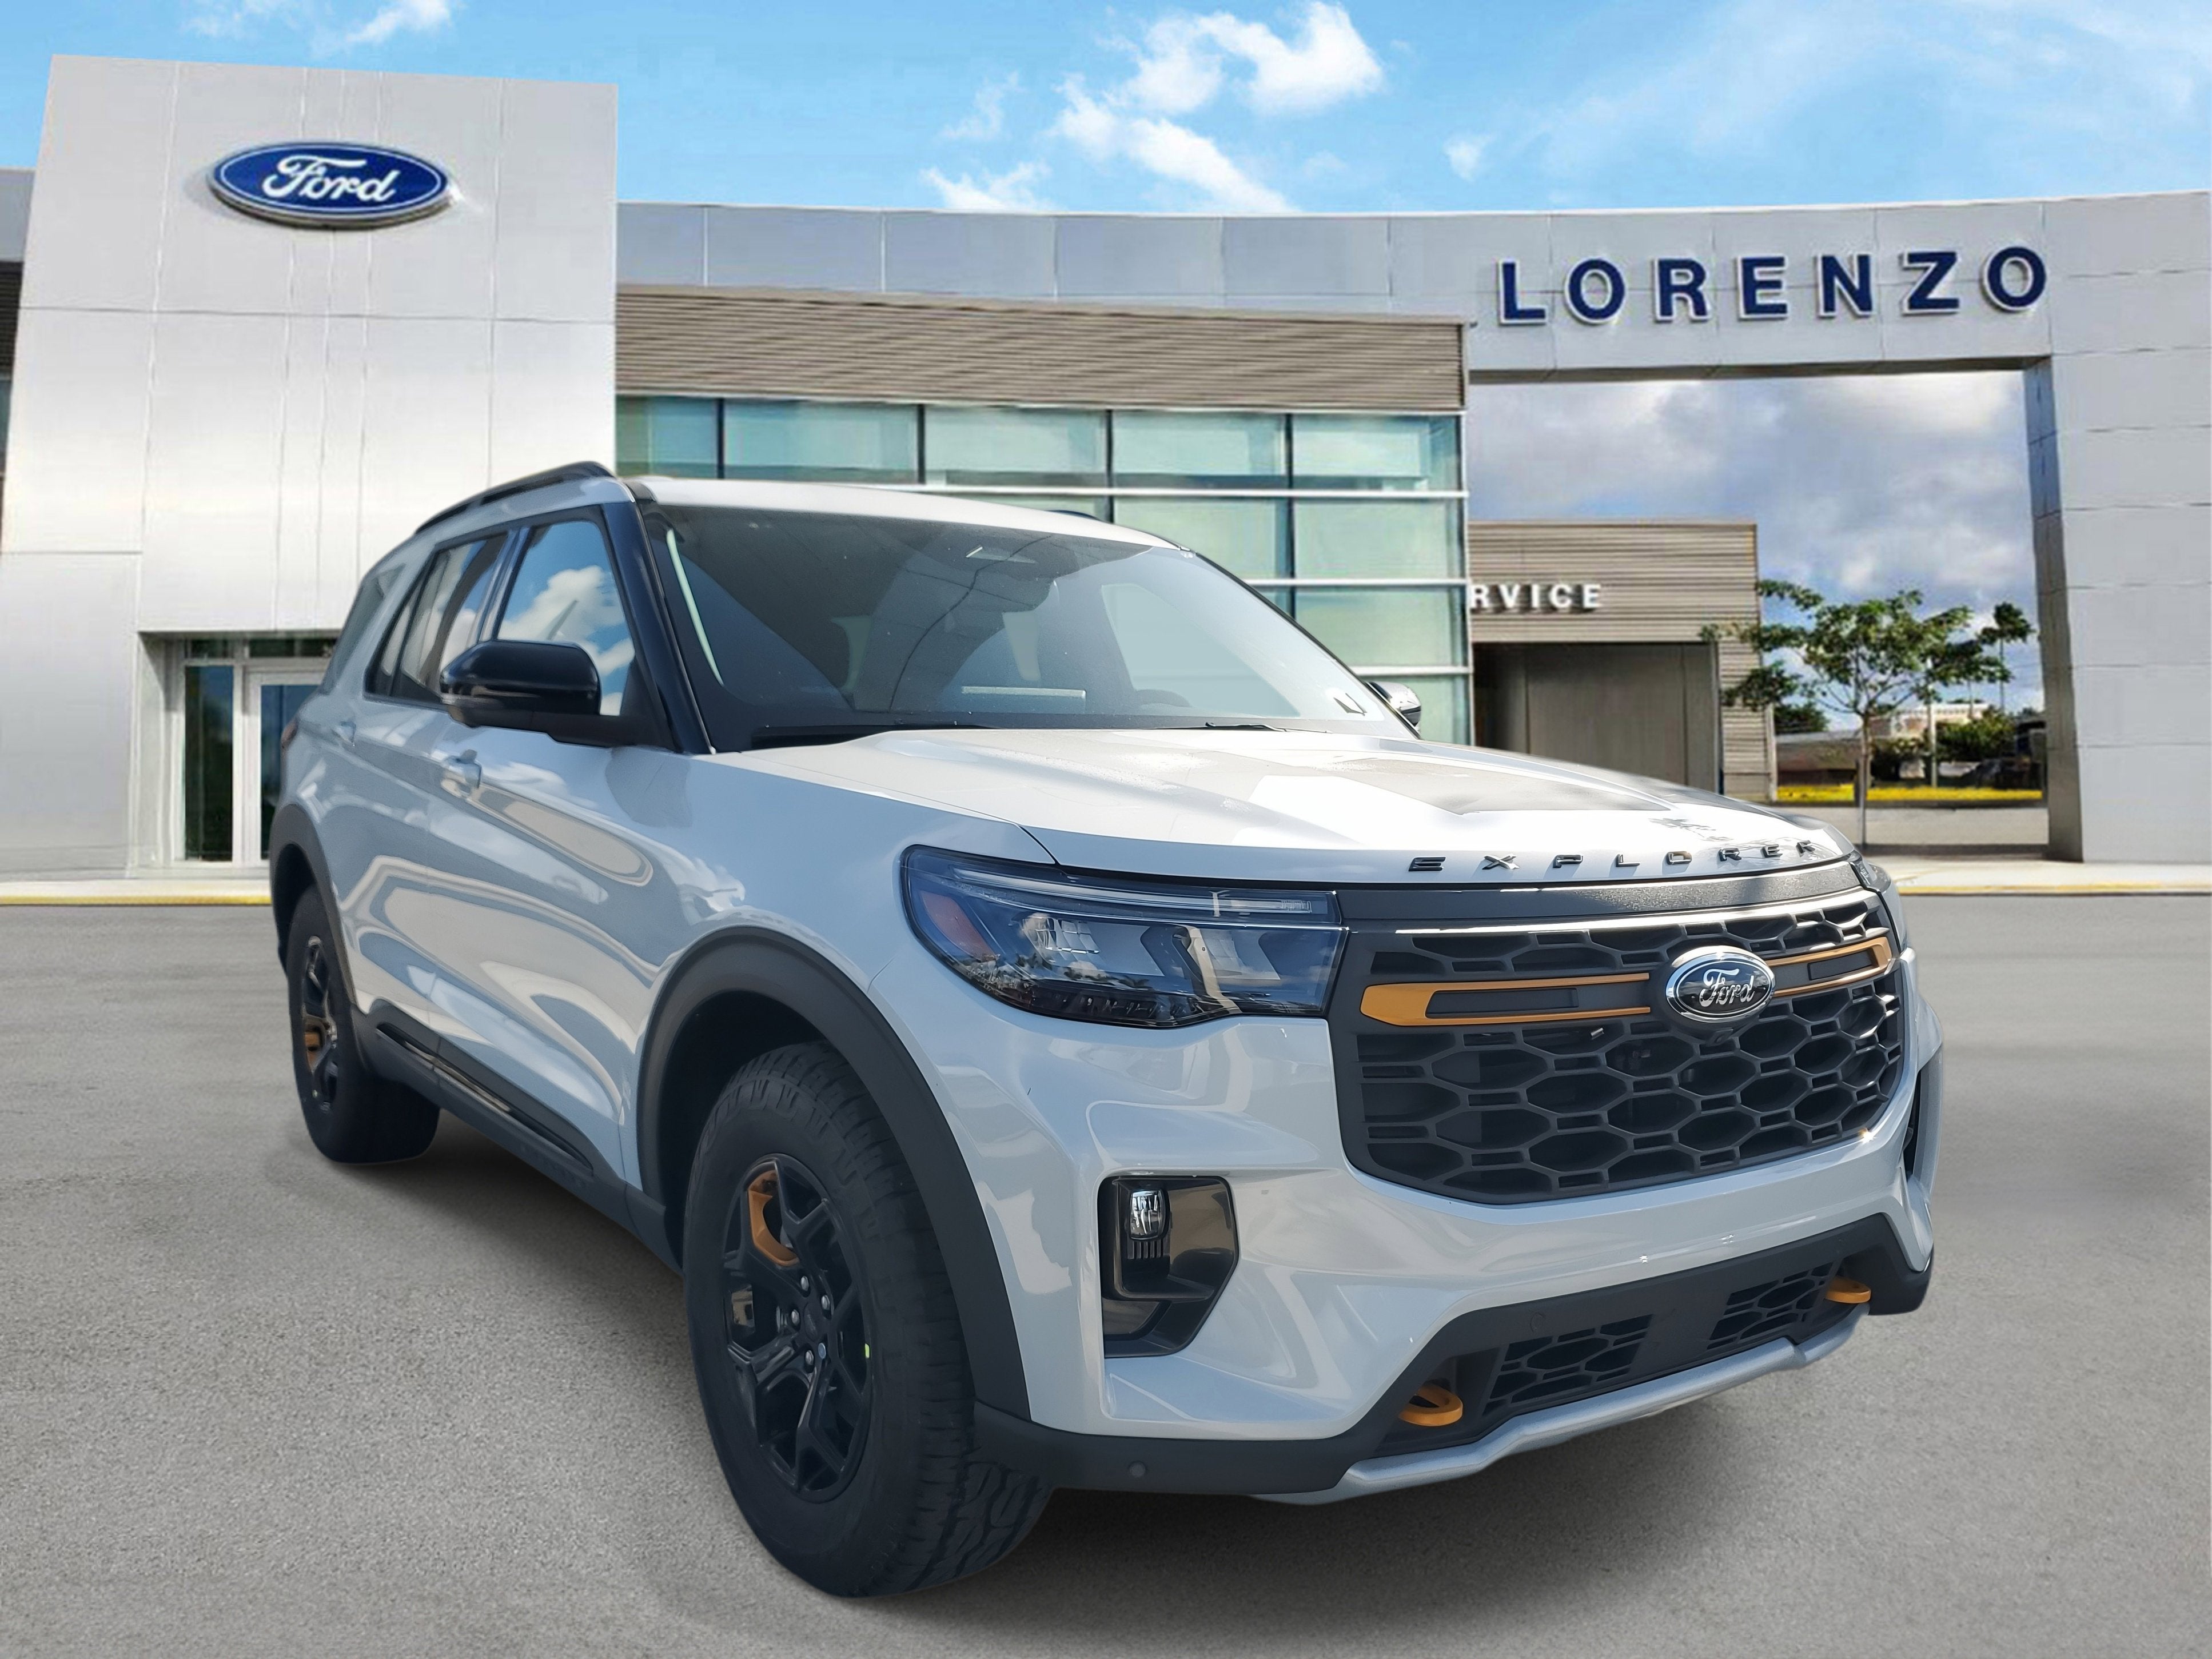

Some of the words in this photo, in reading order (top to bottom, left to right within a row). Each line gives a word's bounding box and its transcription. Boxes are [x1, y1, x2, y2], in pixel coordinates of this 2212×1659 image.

[262, 155, 400, 202] Ford
[1498, 246, 2047, 324] LORENZO
[1408, 840, 1816, 872] EXPLORER
[1699, 968, 1755, 1007] Ford
